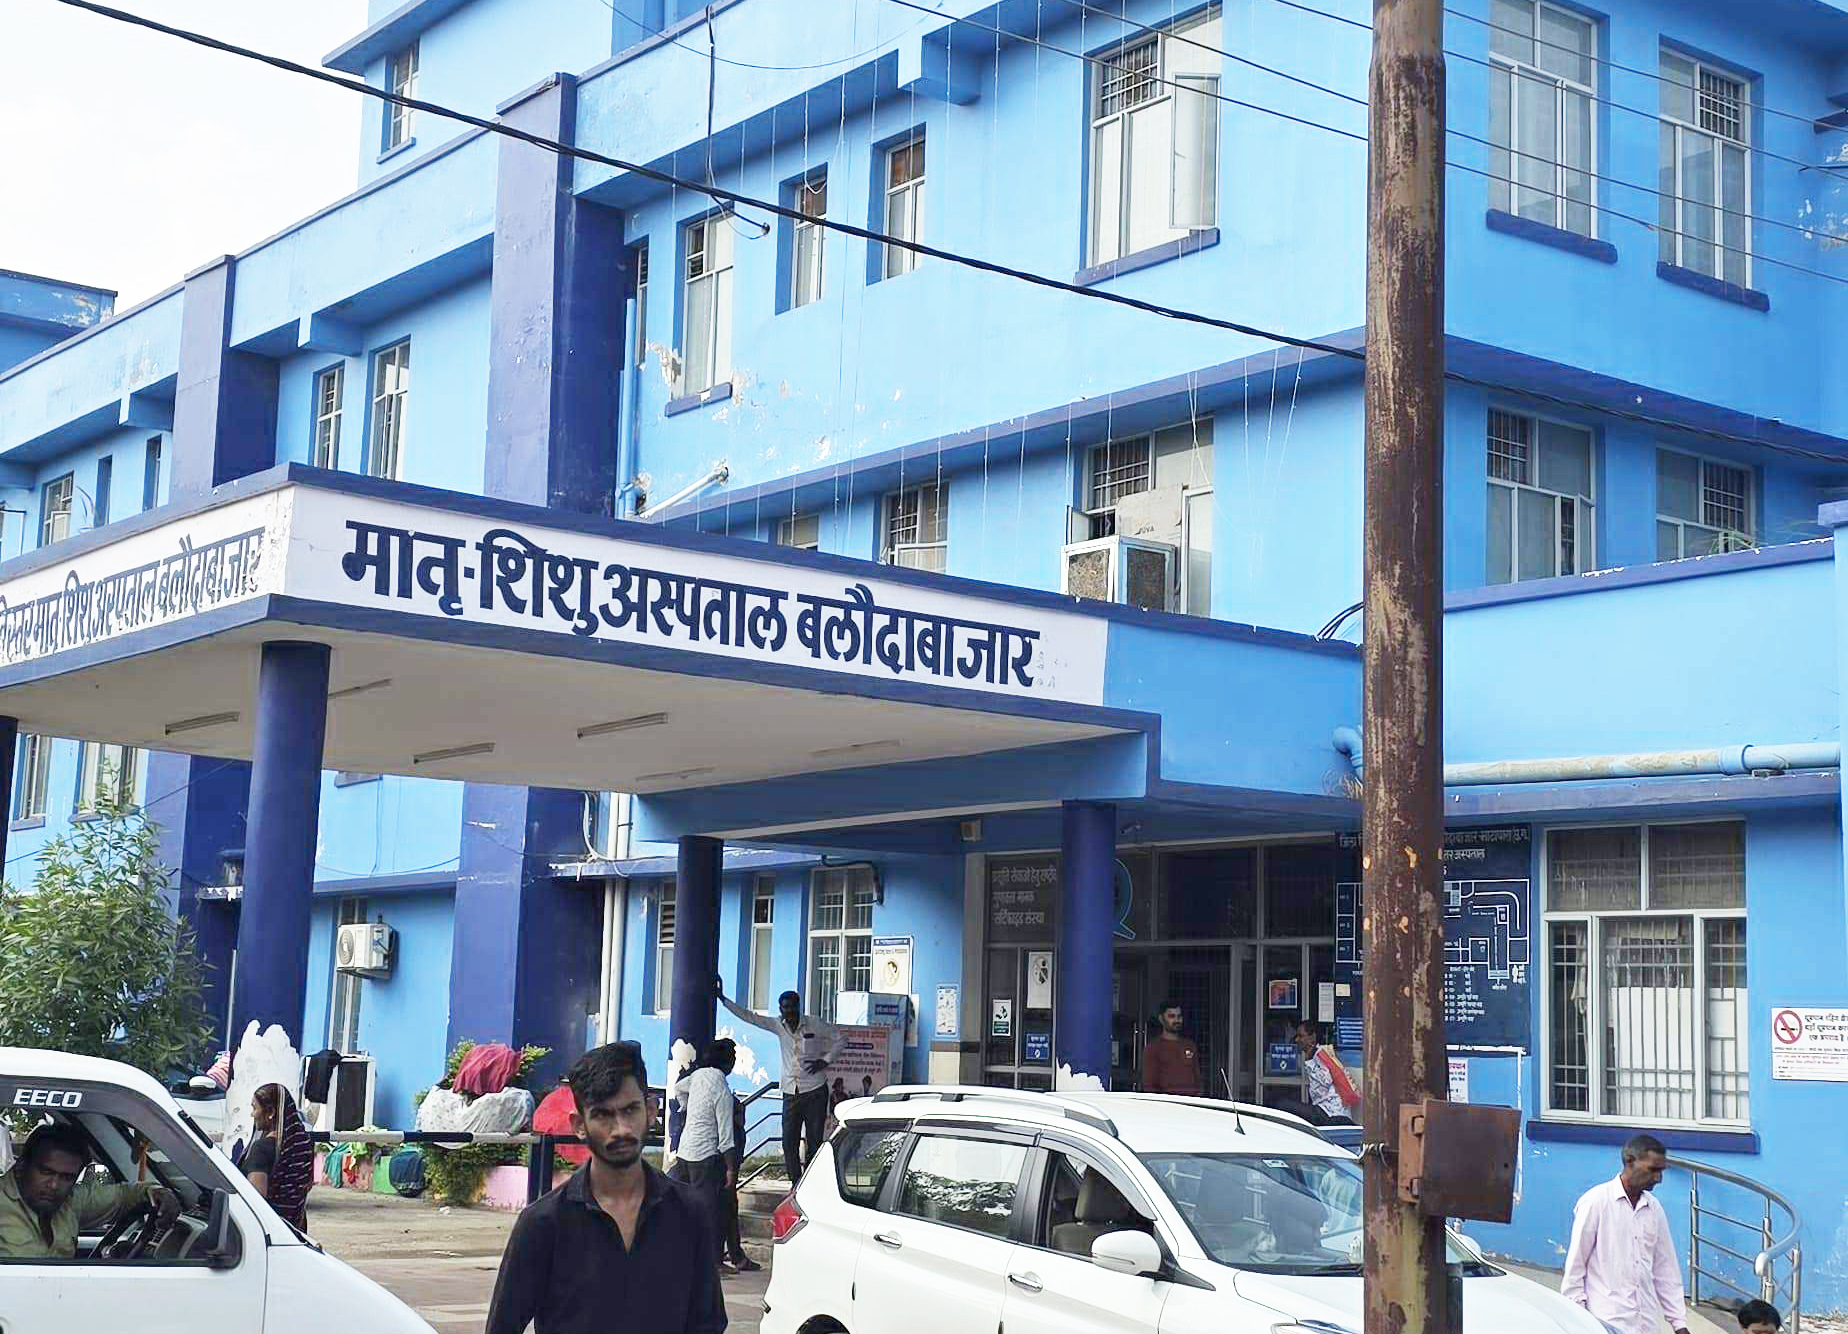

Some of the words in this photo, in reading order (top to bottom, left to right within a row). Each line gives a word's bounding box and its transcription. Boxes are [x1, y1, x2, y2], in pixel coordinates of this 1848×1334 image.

[156, 526, 266, 616] बलौदाबाजार
[342, 520, 600, 637] मातृ-शिशु
[599, 564, 789, 652] अस्पताल
[796, 583, 1041, 687] बलौदाबाजार
[13, 1088, 83, 1108] EECO
